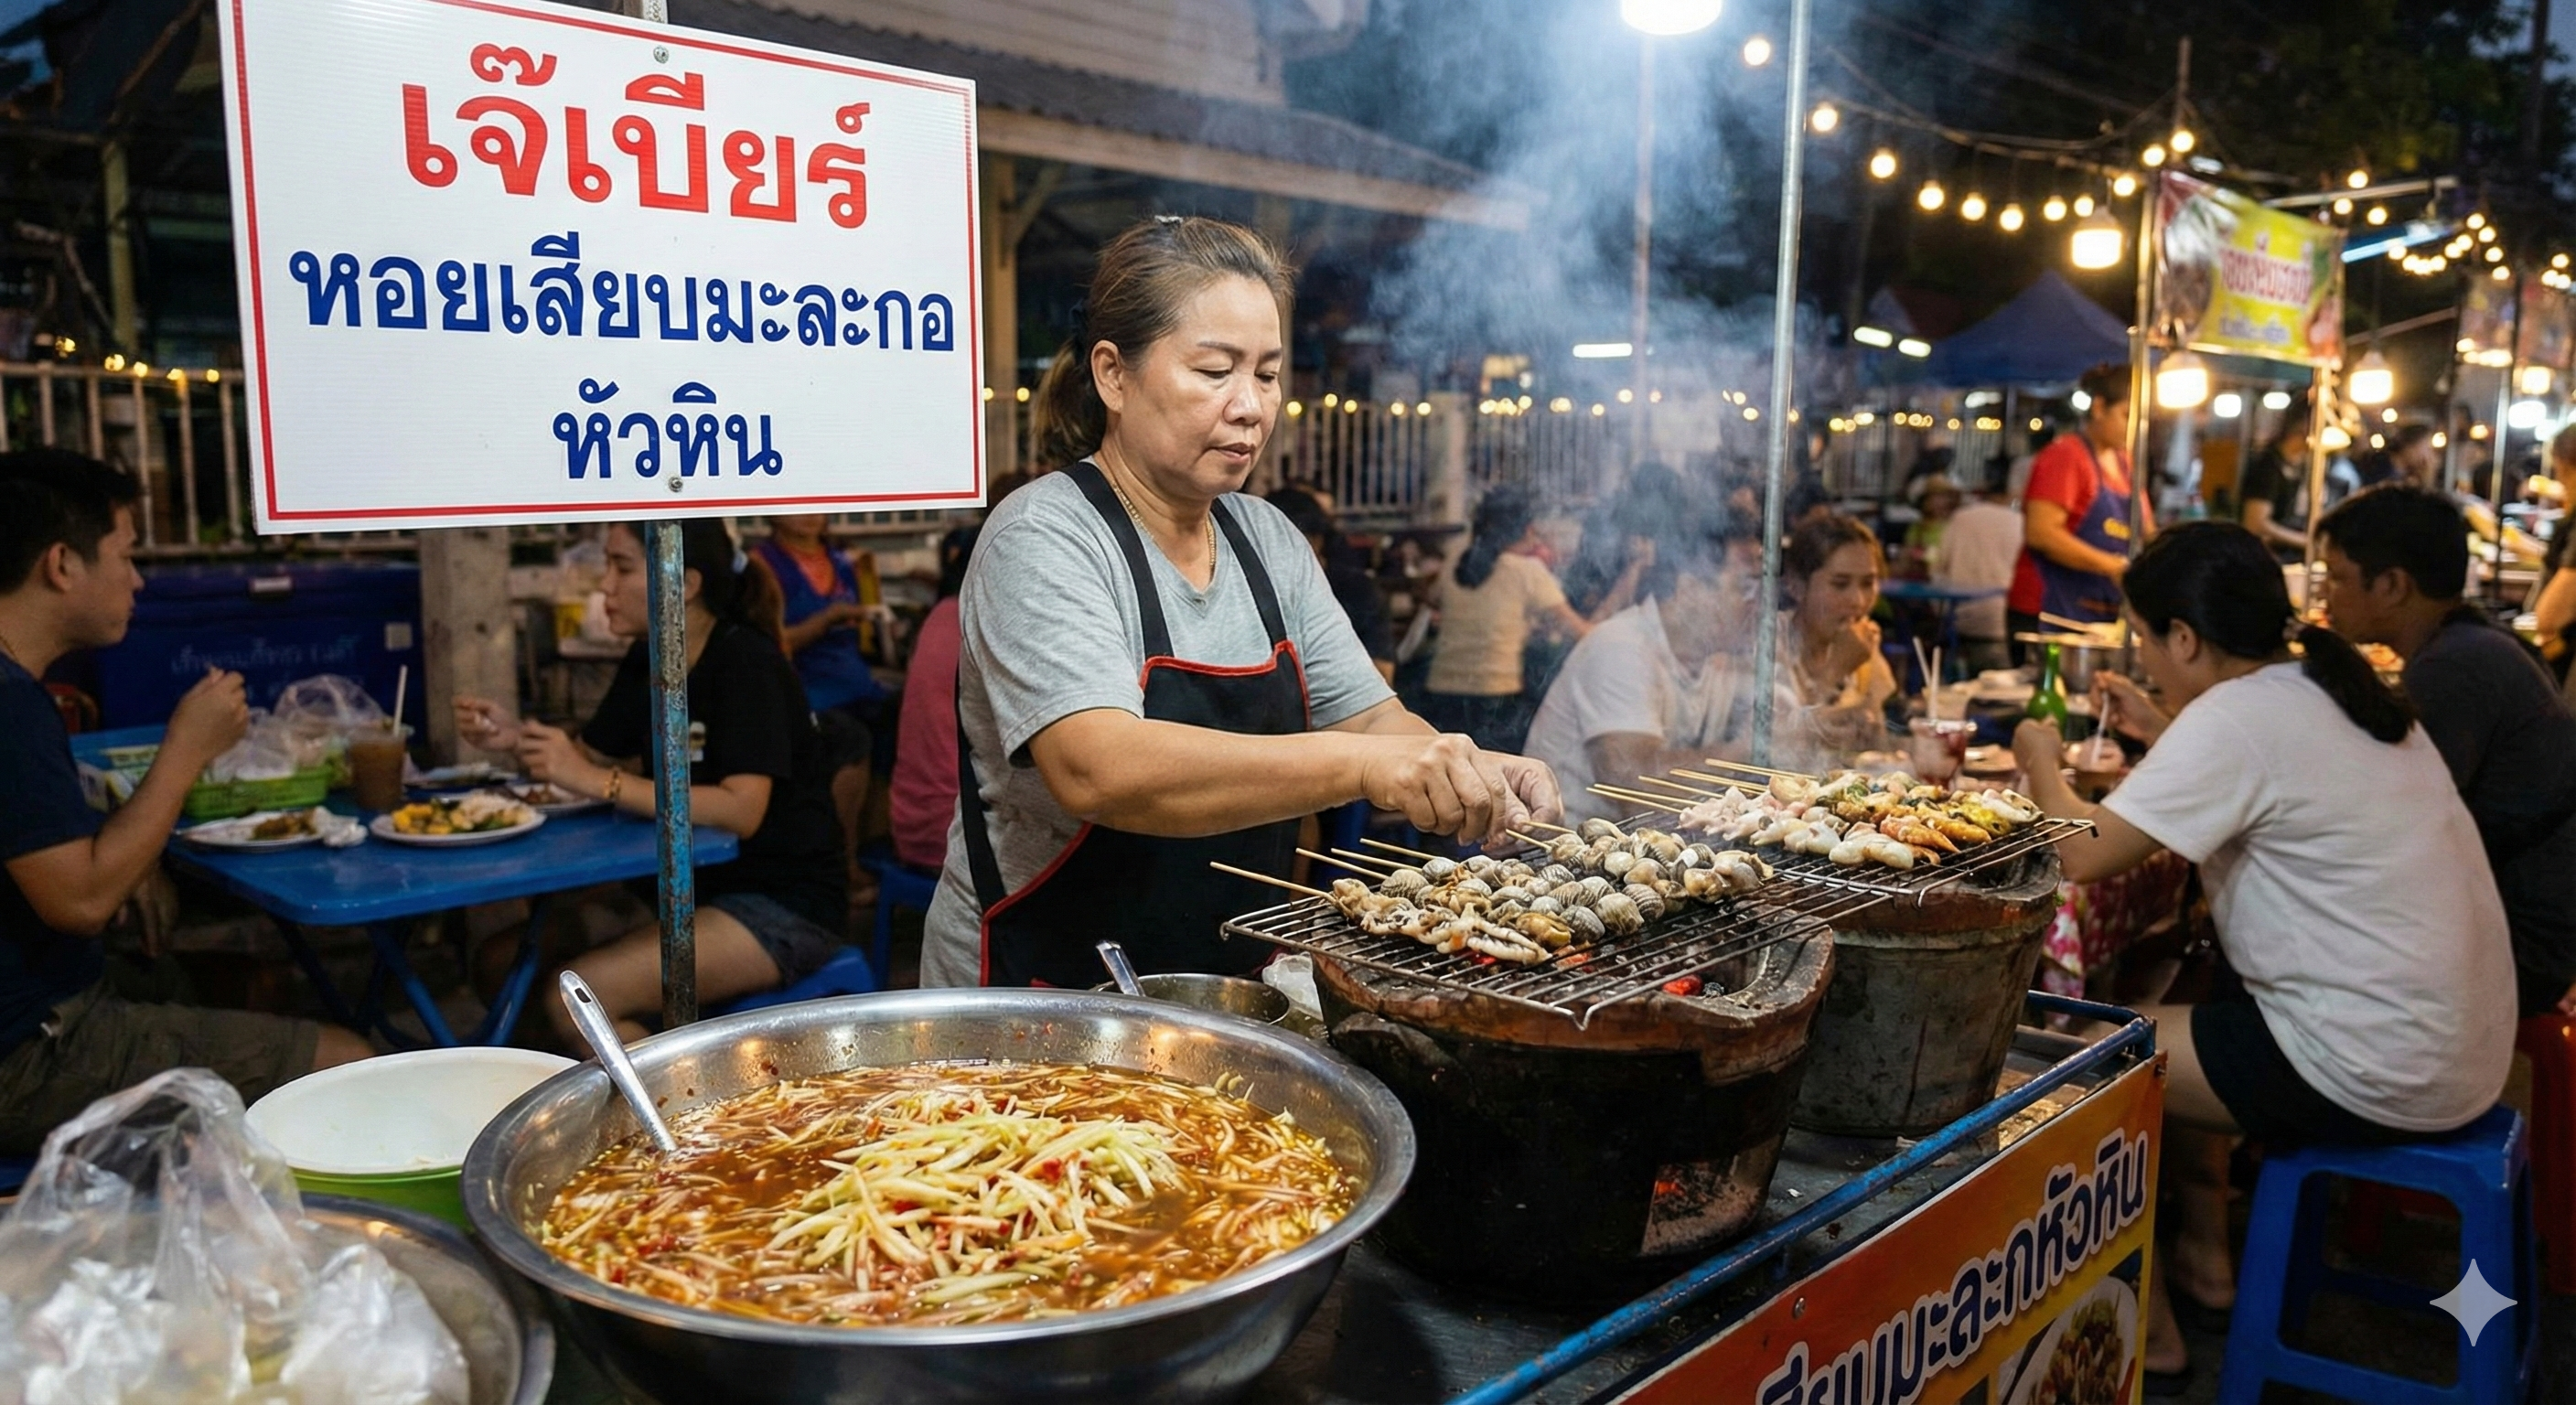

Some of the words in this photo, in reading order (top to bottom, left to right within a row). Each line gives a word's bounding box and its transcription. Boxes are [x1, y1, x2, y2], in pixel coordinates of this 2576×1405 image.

[402, 43, 870, 229] เจ๊เบียร์
[289, 231, 954, 351] หอยเสียบมะละกอ
[553, 378, 783, 479] หัวหิน
[1762, 1136, 2145, 1405] ีบมะละกหัวหิน
